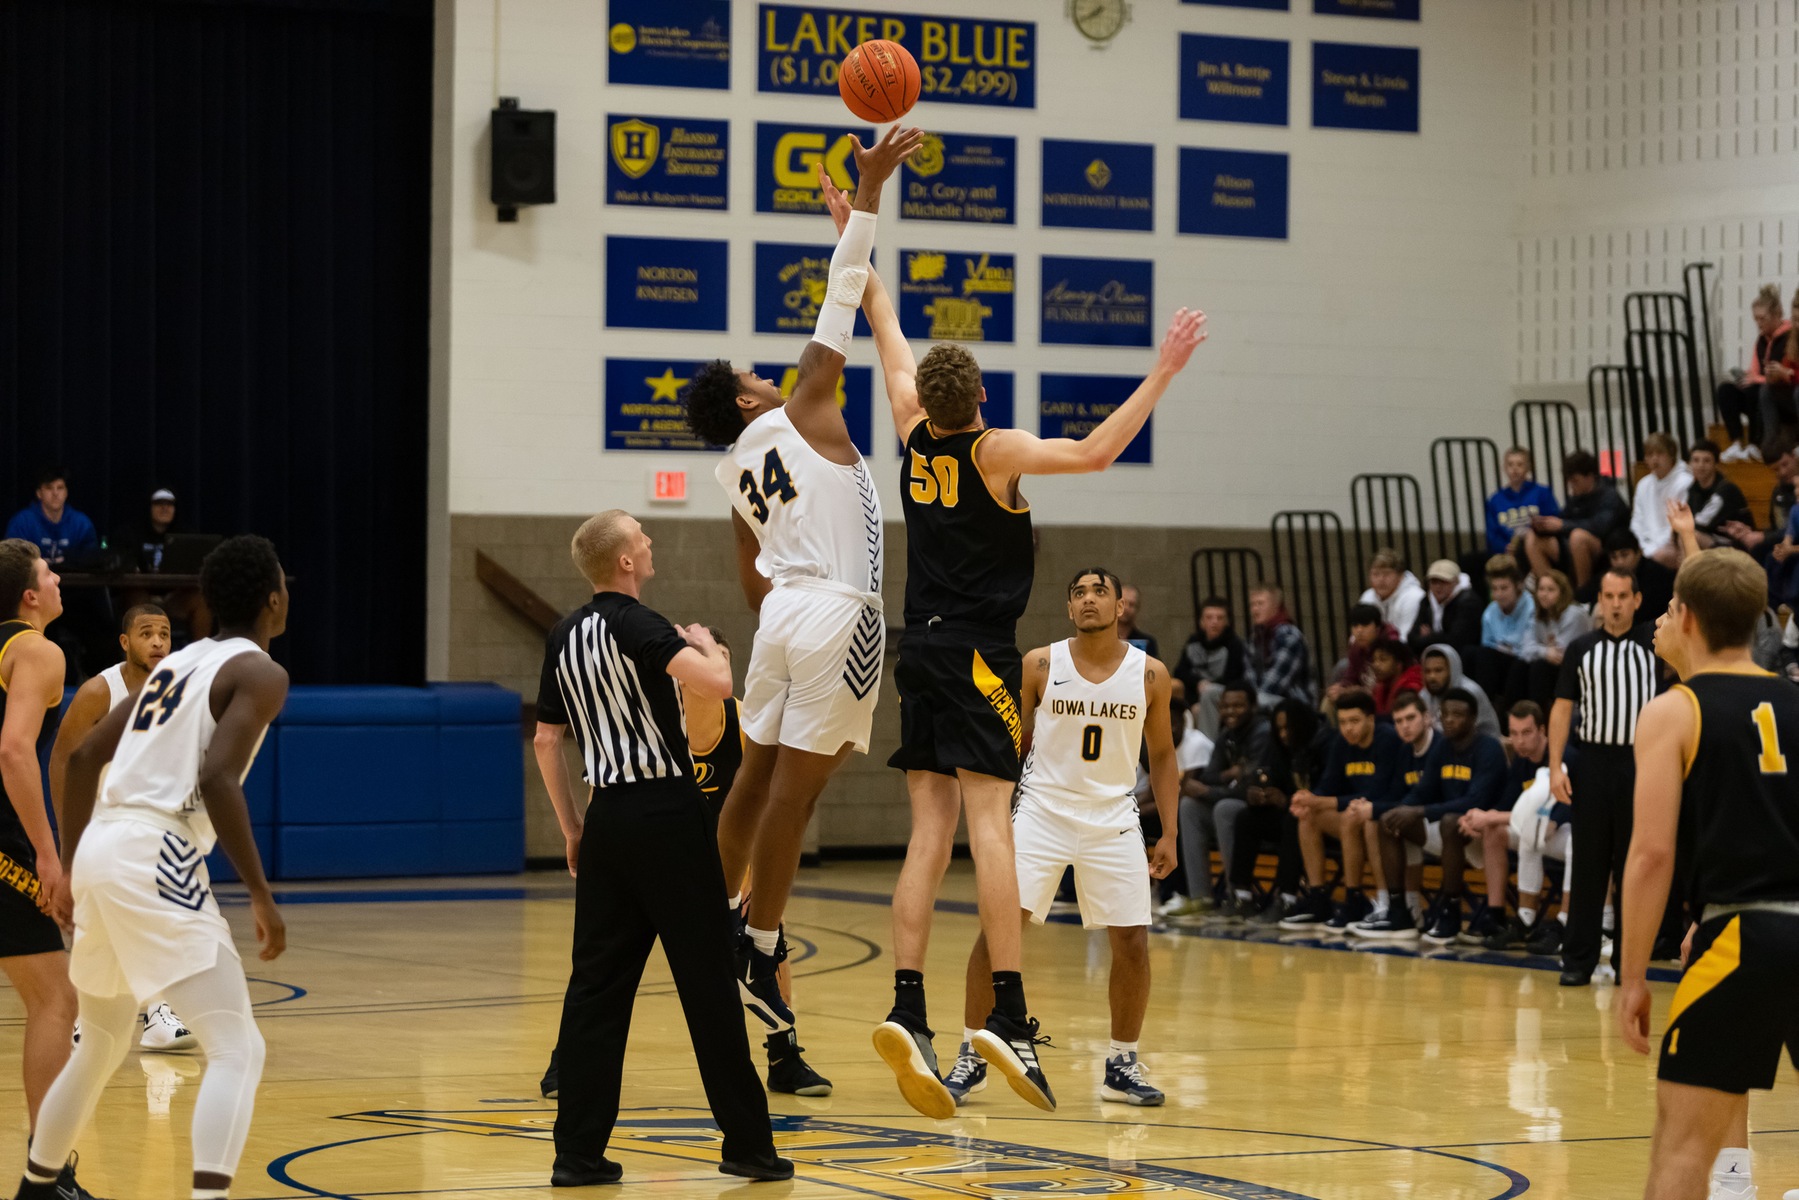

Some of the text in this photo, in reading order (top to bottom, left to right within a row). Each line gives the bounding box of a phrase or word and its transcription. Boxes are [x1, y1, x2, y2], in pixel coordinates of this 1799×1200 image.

[766, 11, 1030, 69] LAKER BLUE
[624, 132, 647, 159] H
[773, 132, 861, 191] GK
[908, 182, 997, 204] Dr. Cory and
[637, 266, 698, 282] NORTON
[636, 285, 698, 303] KNUTSEN
[1045, 305, 1146, 325] FUNERAL HOME
[1041, 400, 1074, 418] GARY
[738, 445, 799, 526] 34
[909, 447, 960, 508] 50
[132, 667, 199, 733] 24
[1052, 699, 1138, 720] IOWA LAKES
[1081, 724, 1104, 762] 0
[1750, 701, 1788, 774] 1
